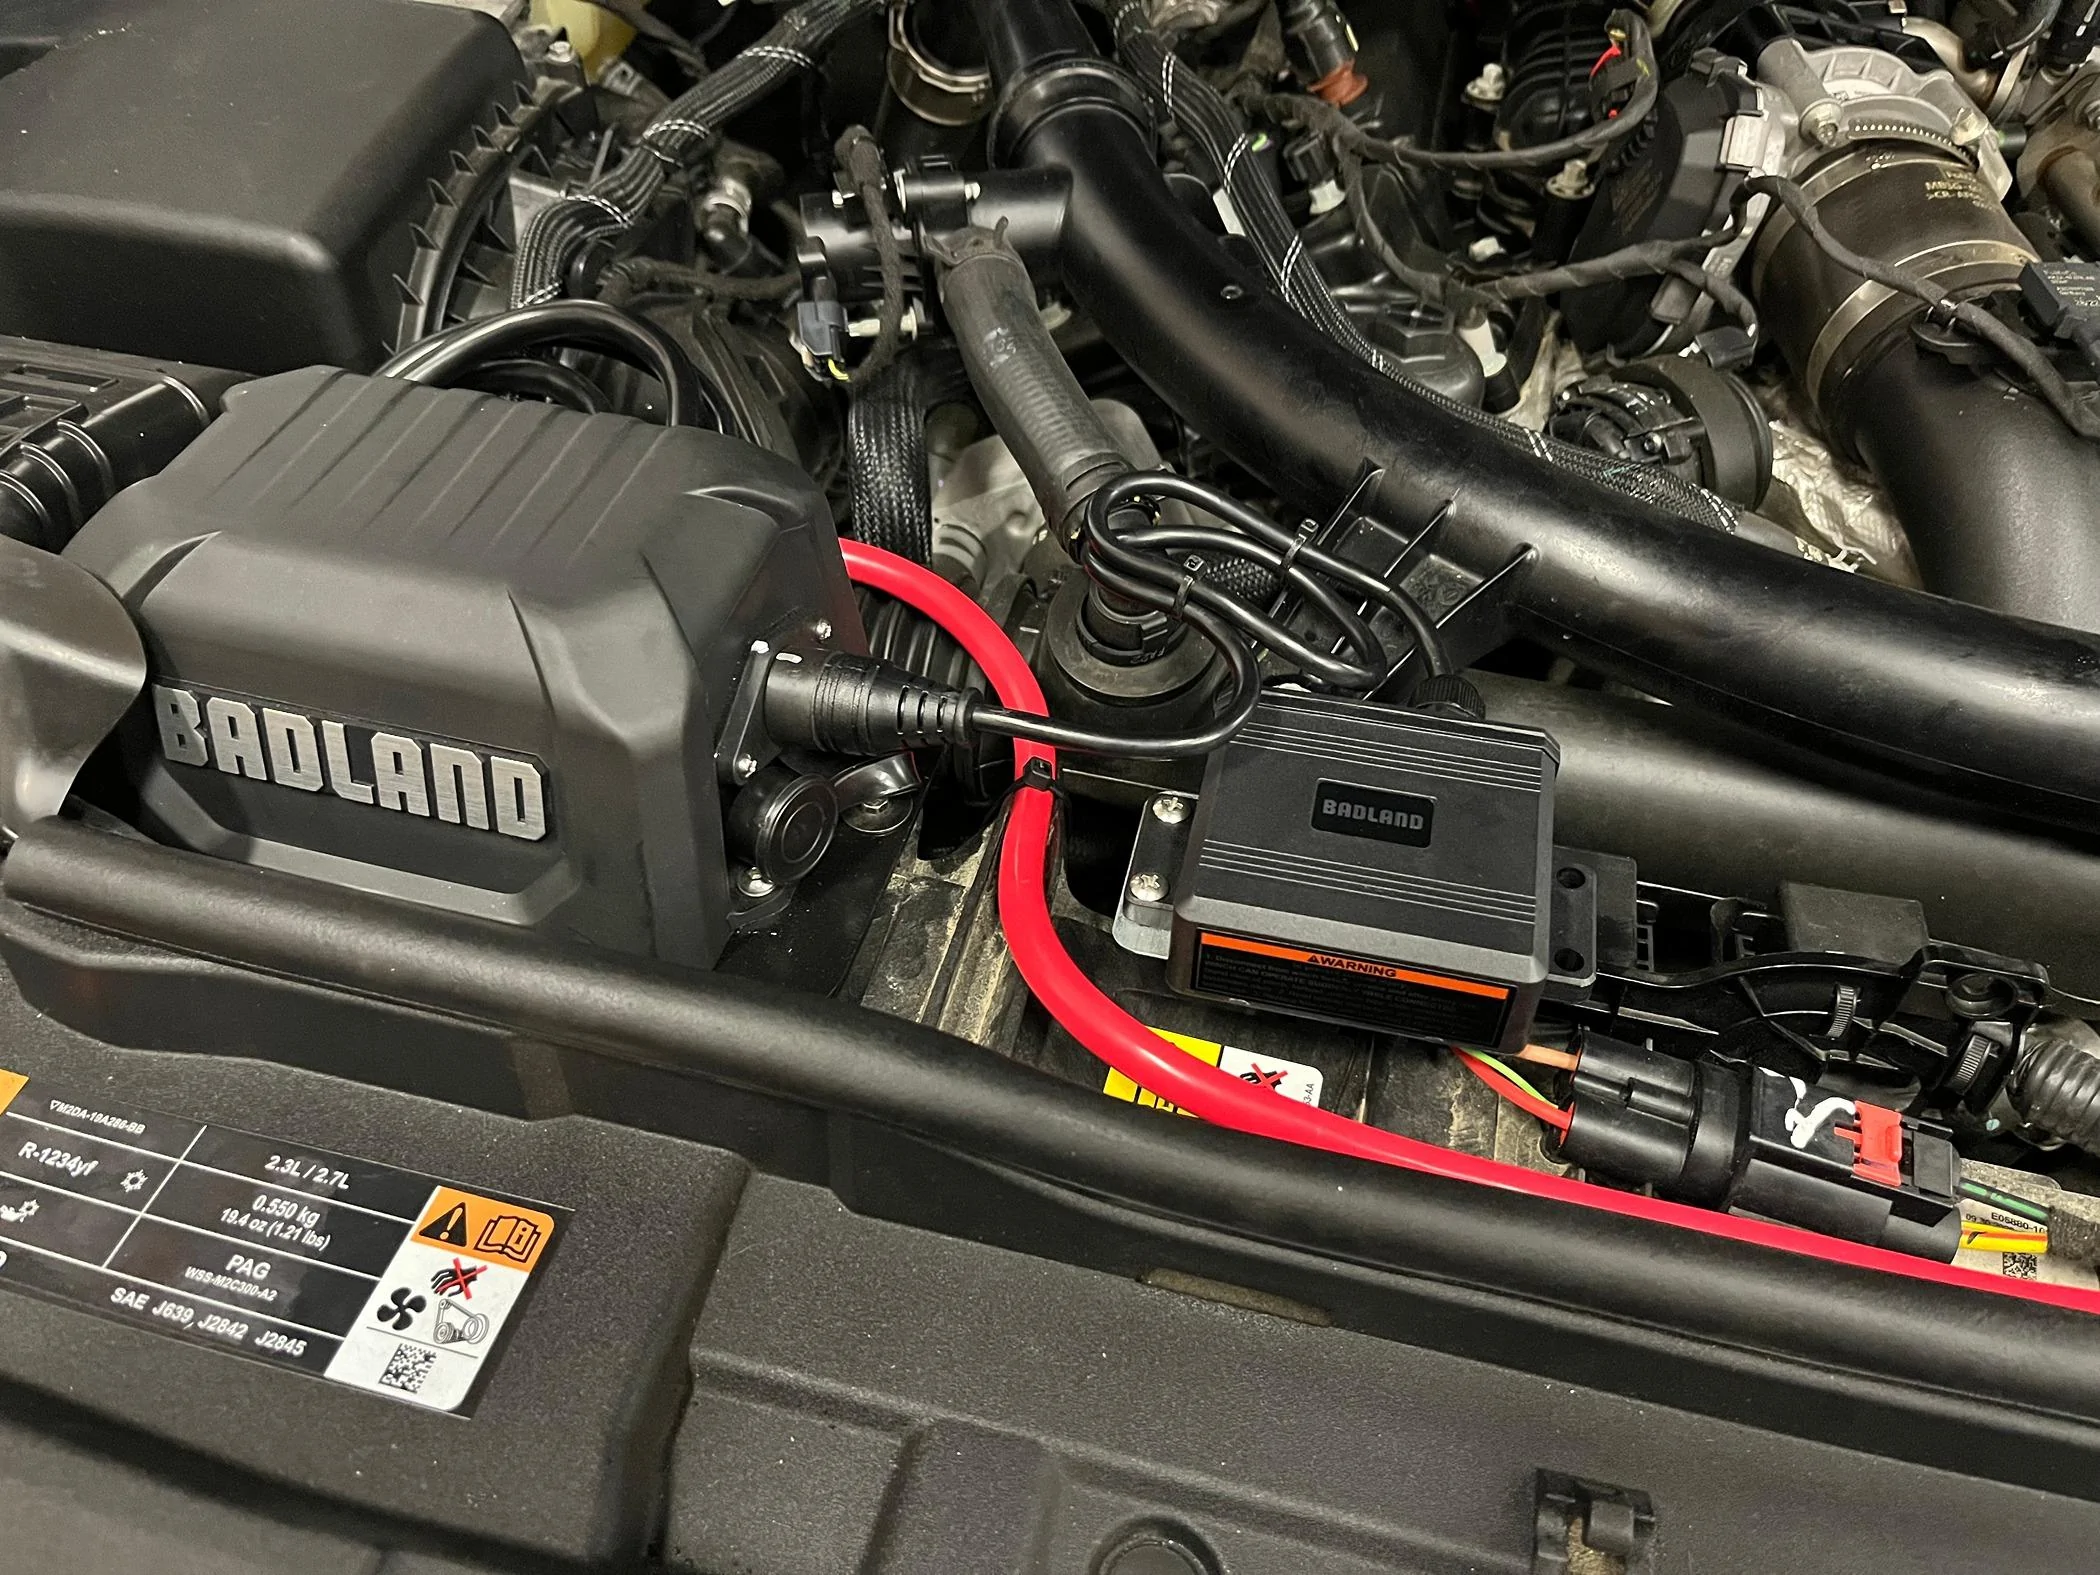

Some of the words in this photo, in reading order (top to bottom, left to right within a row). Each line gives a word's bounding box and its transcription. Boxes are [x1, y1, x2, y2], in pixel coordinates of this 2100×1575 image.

[153, 684, 548, 842] BADLAND
[1322, 799, 1424, 830] BADLAND
[1320, 956, 1397, 977] WARNING
[18, 1141, 99, 1178] R-1234yf
[264, 1155, 301, 1177] 2.3L
[302, 1164, 317, 1179] /
[312, 1167, 350, 1190] 2.7L
[220, 1207, 251, 1227] 19.4
[248, 1218, 269, 1233] oz
[266, 1220, 303, 1241] (1.21
[301, 1230, 331, 1251] lbs)
[252, 1194, 299, 1220] 0.550
[296, 1205, 321, 1229] kg
[184, 1266, 278, 1302] WSS-M2C300-A2
[224, 1254, 271, 1281] PAG
[110, 1287, 150, 1311] SAE
[152, 1300, 195, 1330] J639,
[197, 1314, 249, 1340] J2842
[254, 1330, 308, 1357] J2845
